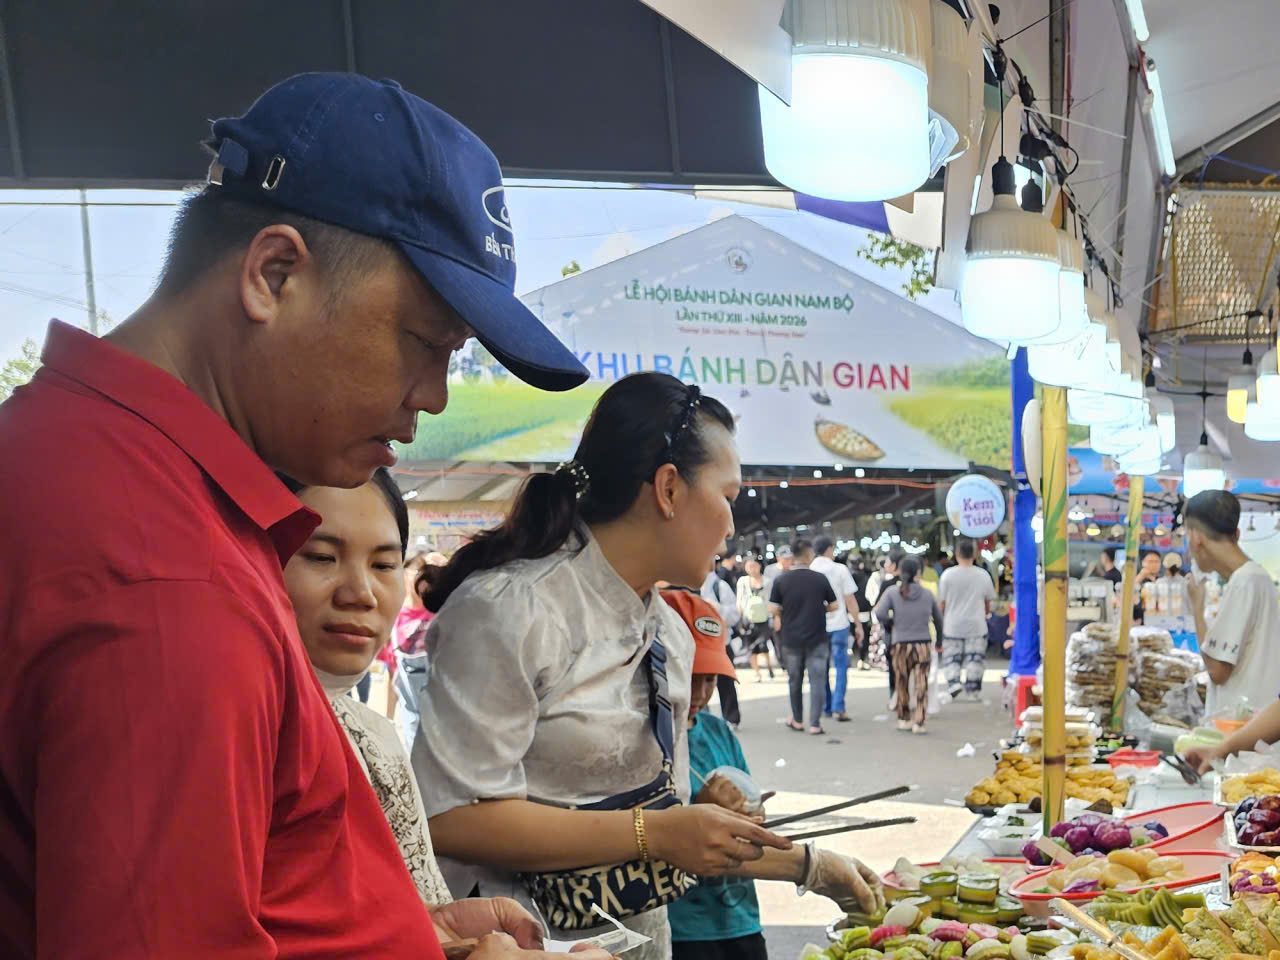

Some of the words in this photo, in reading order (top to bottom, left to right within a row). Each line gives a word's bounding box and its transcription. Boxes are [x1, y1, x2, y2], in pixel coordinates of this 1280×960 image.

[624, 280, 641, 300] LỄ
[645, 284, 671, 303] HỘI
[674, 285, 715, 304] BÁNH
[720, 288, 751, 305] DÂN
[755, 291, 792, 307] GIAN
[795, 294, 831, 309] NAM
[834, 293, 854, 313] BỘ
[727, 311, 743, 323] XIII
[751, 311, 778, 325] NĂM
[780, 314, 807, 327] 2026
[653, 347, 746, 385] BÁNH
[833, 362, 911, 391] GIAN
[963, 497, 994, 511] Kem
